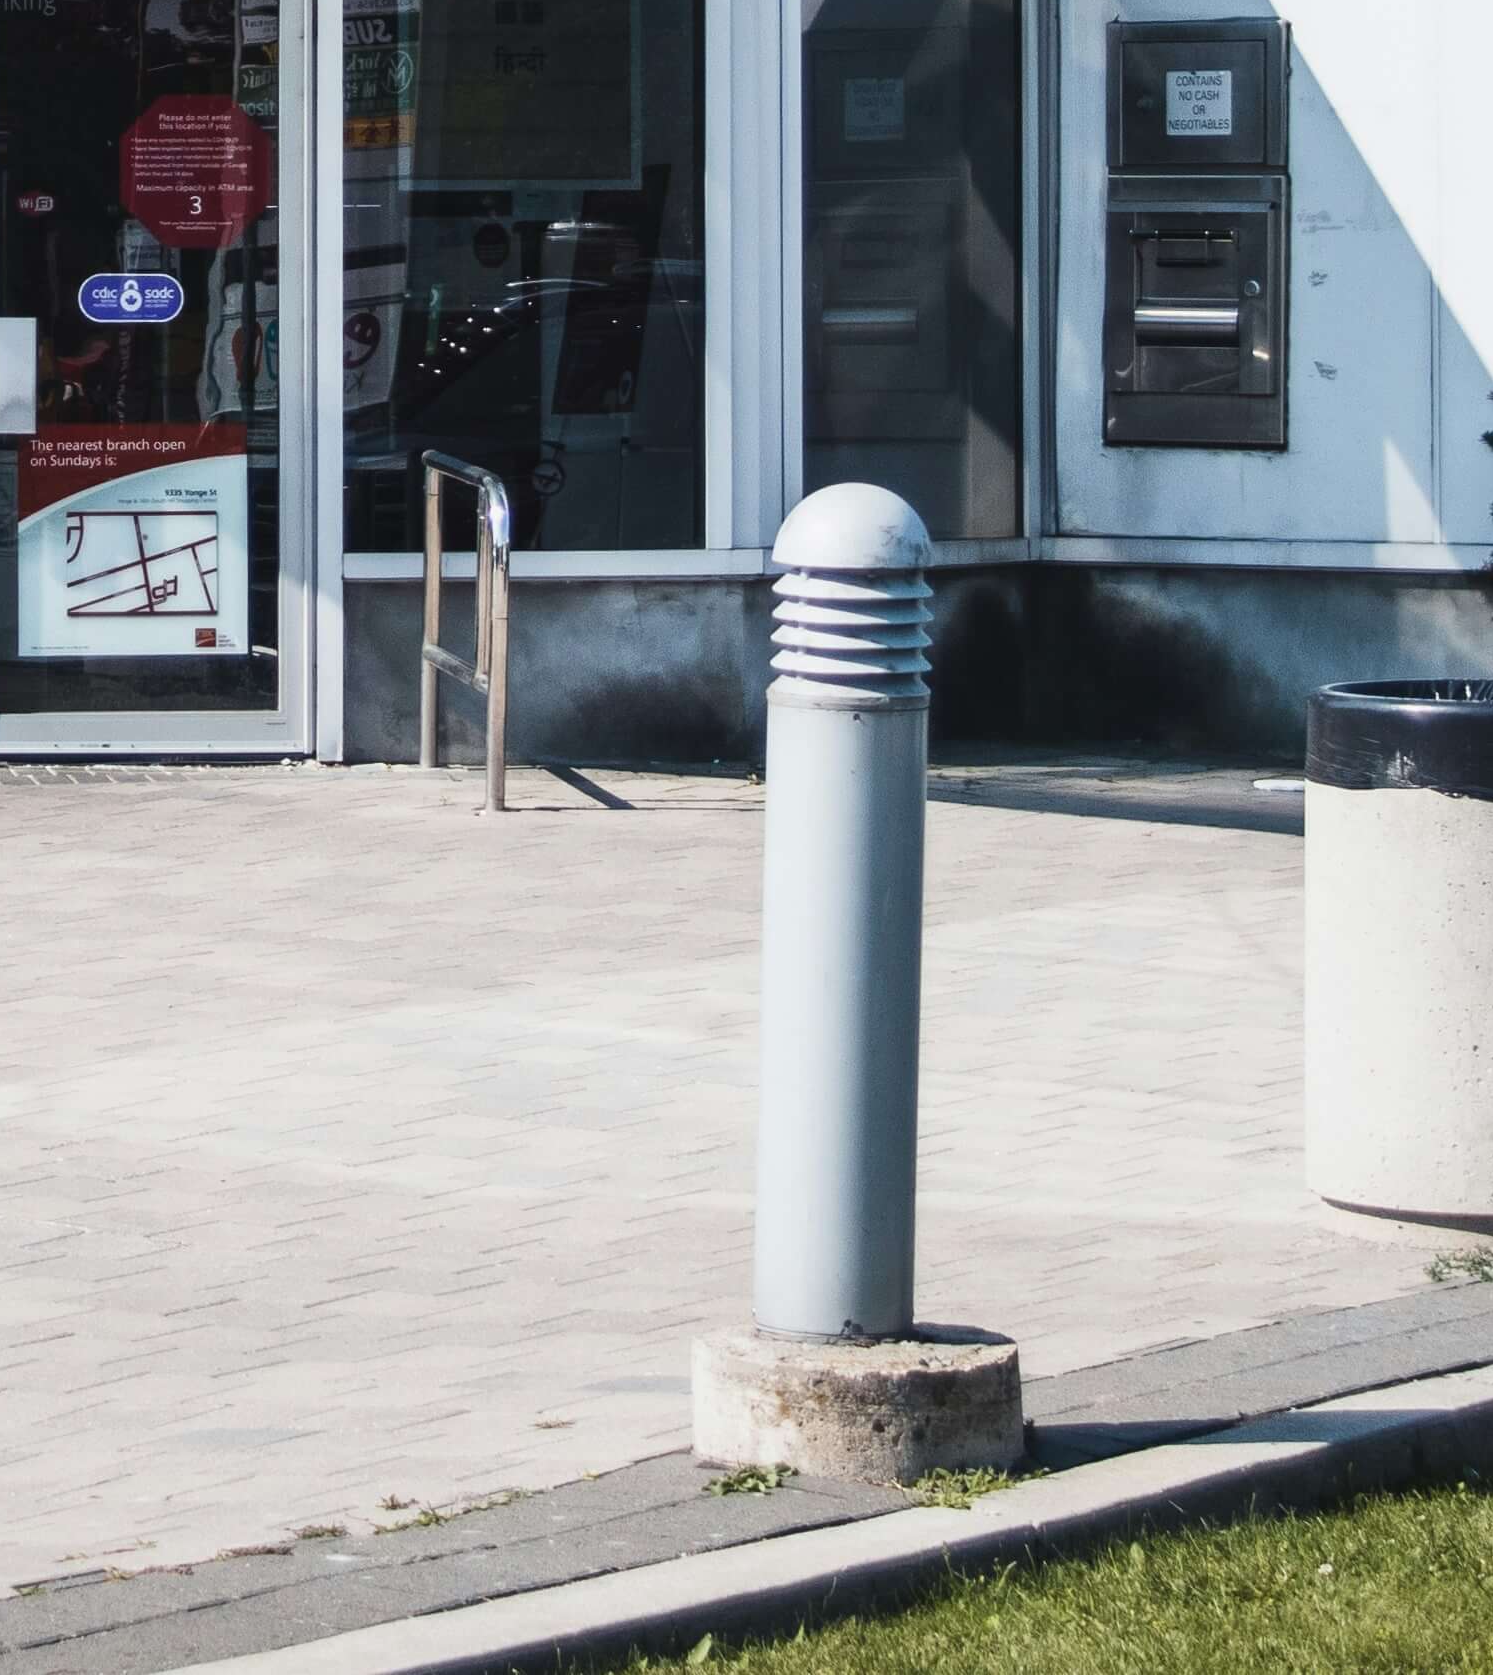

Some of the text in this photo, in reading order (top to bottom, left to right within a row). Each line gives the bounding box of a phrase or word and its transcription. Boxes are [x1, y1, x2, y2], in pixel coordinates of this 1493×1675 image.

[1176, 75, 1222, 86] CONTAINS
[1178, 90, 1219, 101] NO CASH
[1192, 104, 1206, 115] OR
[1168, 118, 1230, 130] NEGOTIABLES
[175, 184, 206, 192] capacity
[190, 195, 202, 214] 3
[92, 286, 174, 299] cdic sadc
[31, 439, 186, 452] The nearest branch open
[30, 454, 117, 468] on Sundays is:
